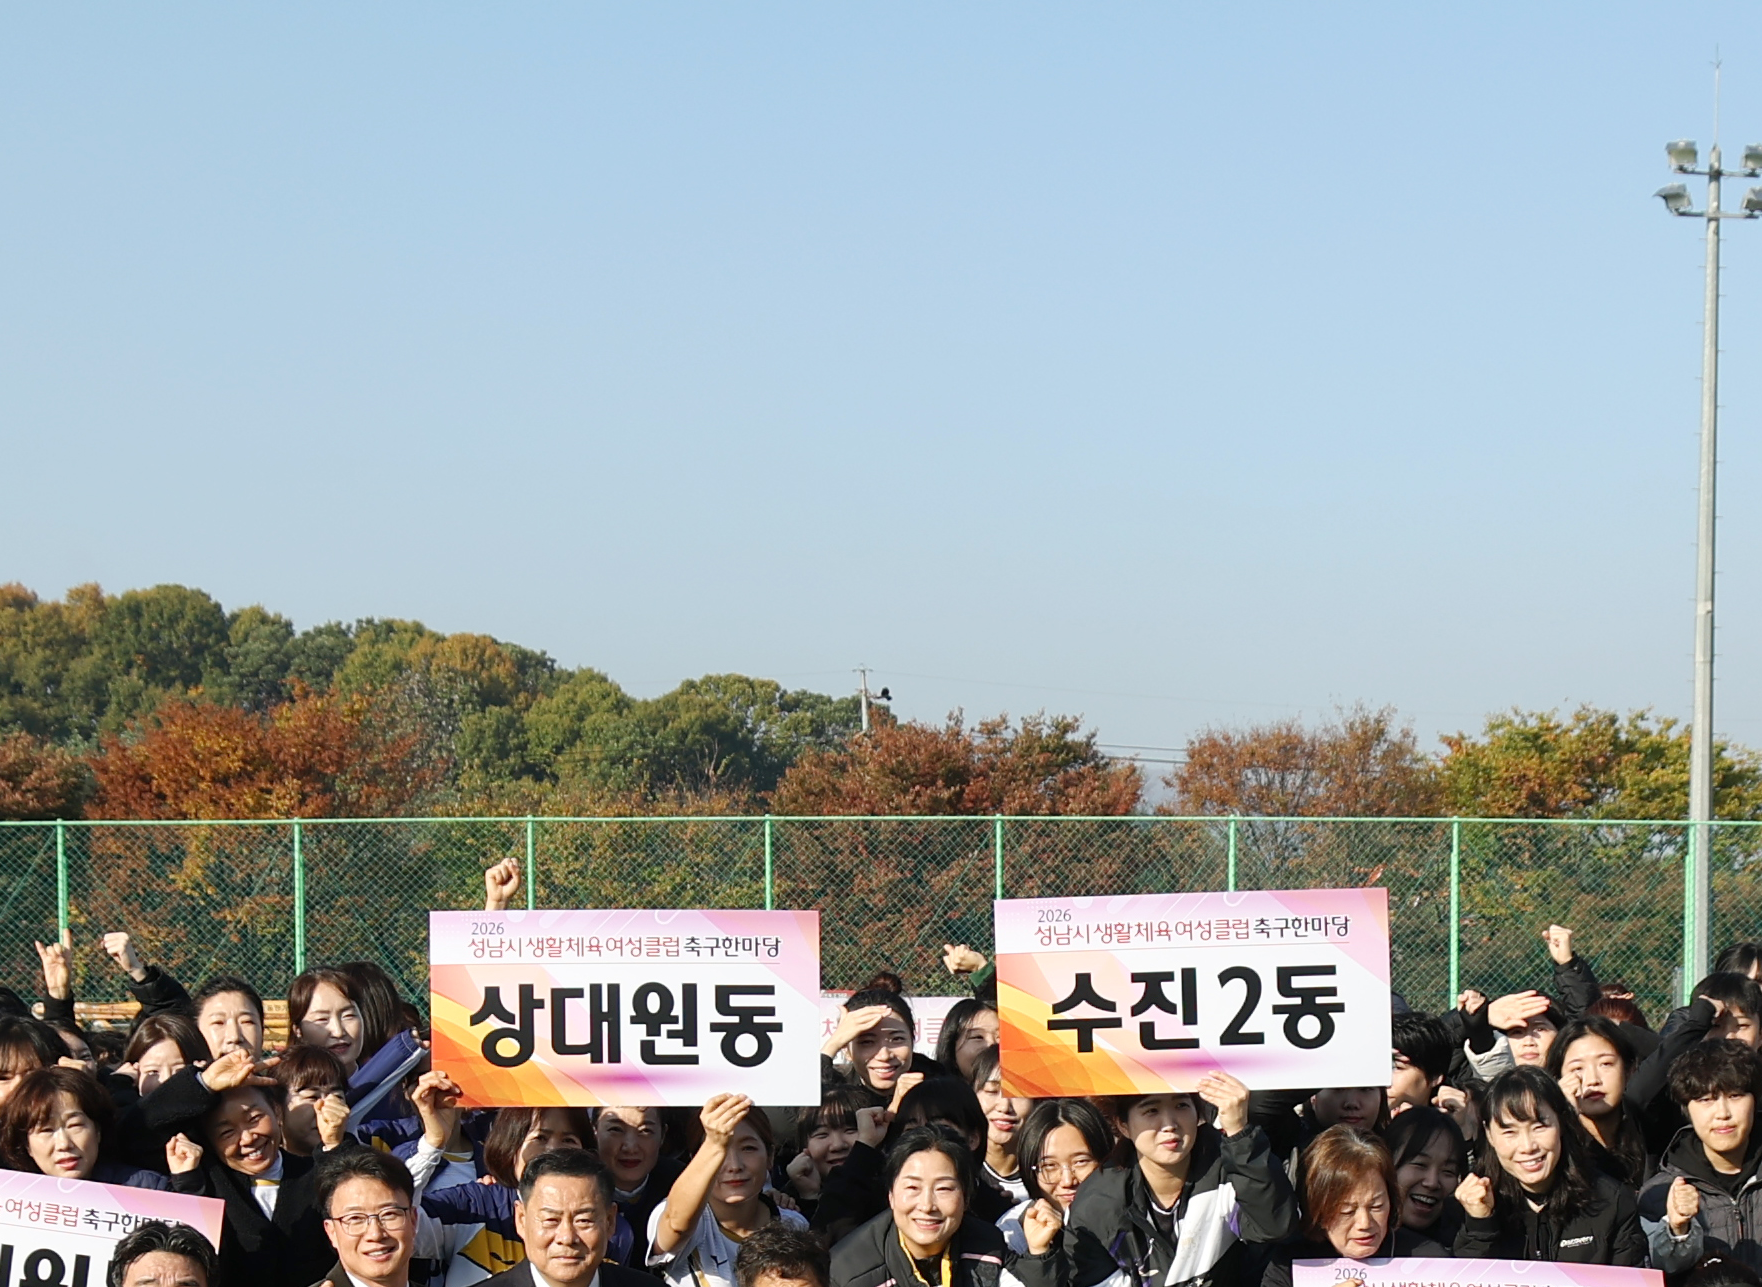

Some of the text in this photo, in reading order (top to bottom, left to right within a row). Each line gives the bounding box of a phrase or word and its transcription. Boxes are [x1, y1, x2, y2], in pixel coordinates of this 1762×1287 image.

[471, 922, 504, 935] 2026
[1037, 909, 1072, 923] 2026
[1034, 915, 1350, 946] 성남시 생활체육 여성클럽 축구한마당
[467, 936, 781, 958] 성남시 생활체육 여성클럽 축구한마당
[1047, 965, 1345, 1053] 수진2동
[469, 981, 783, 1067] 상대원동
[4, 1198, 78, 1228] 여성클럽
[1335, 1267, 1367, 1281] 2026
